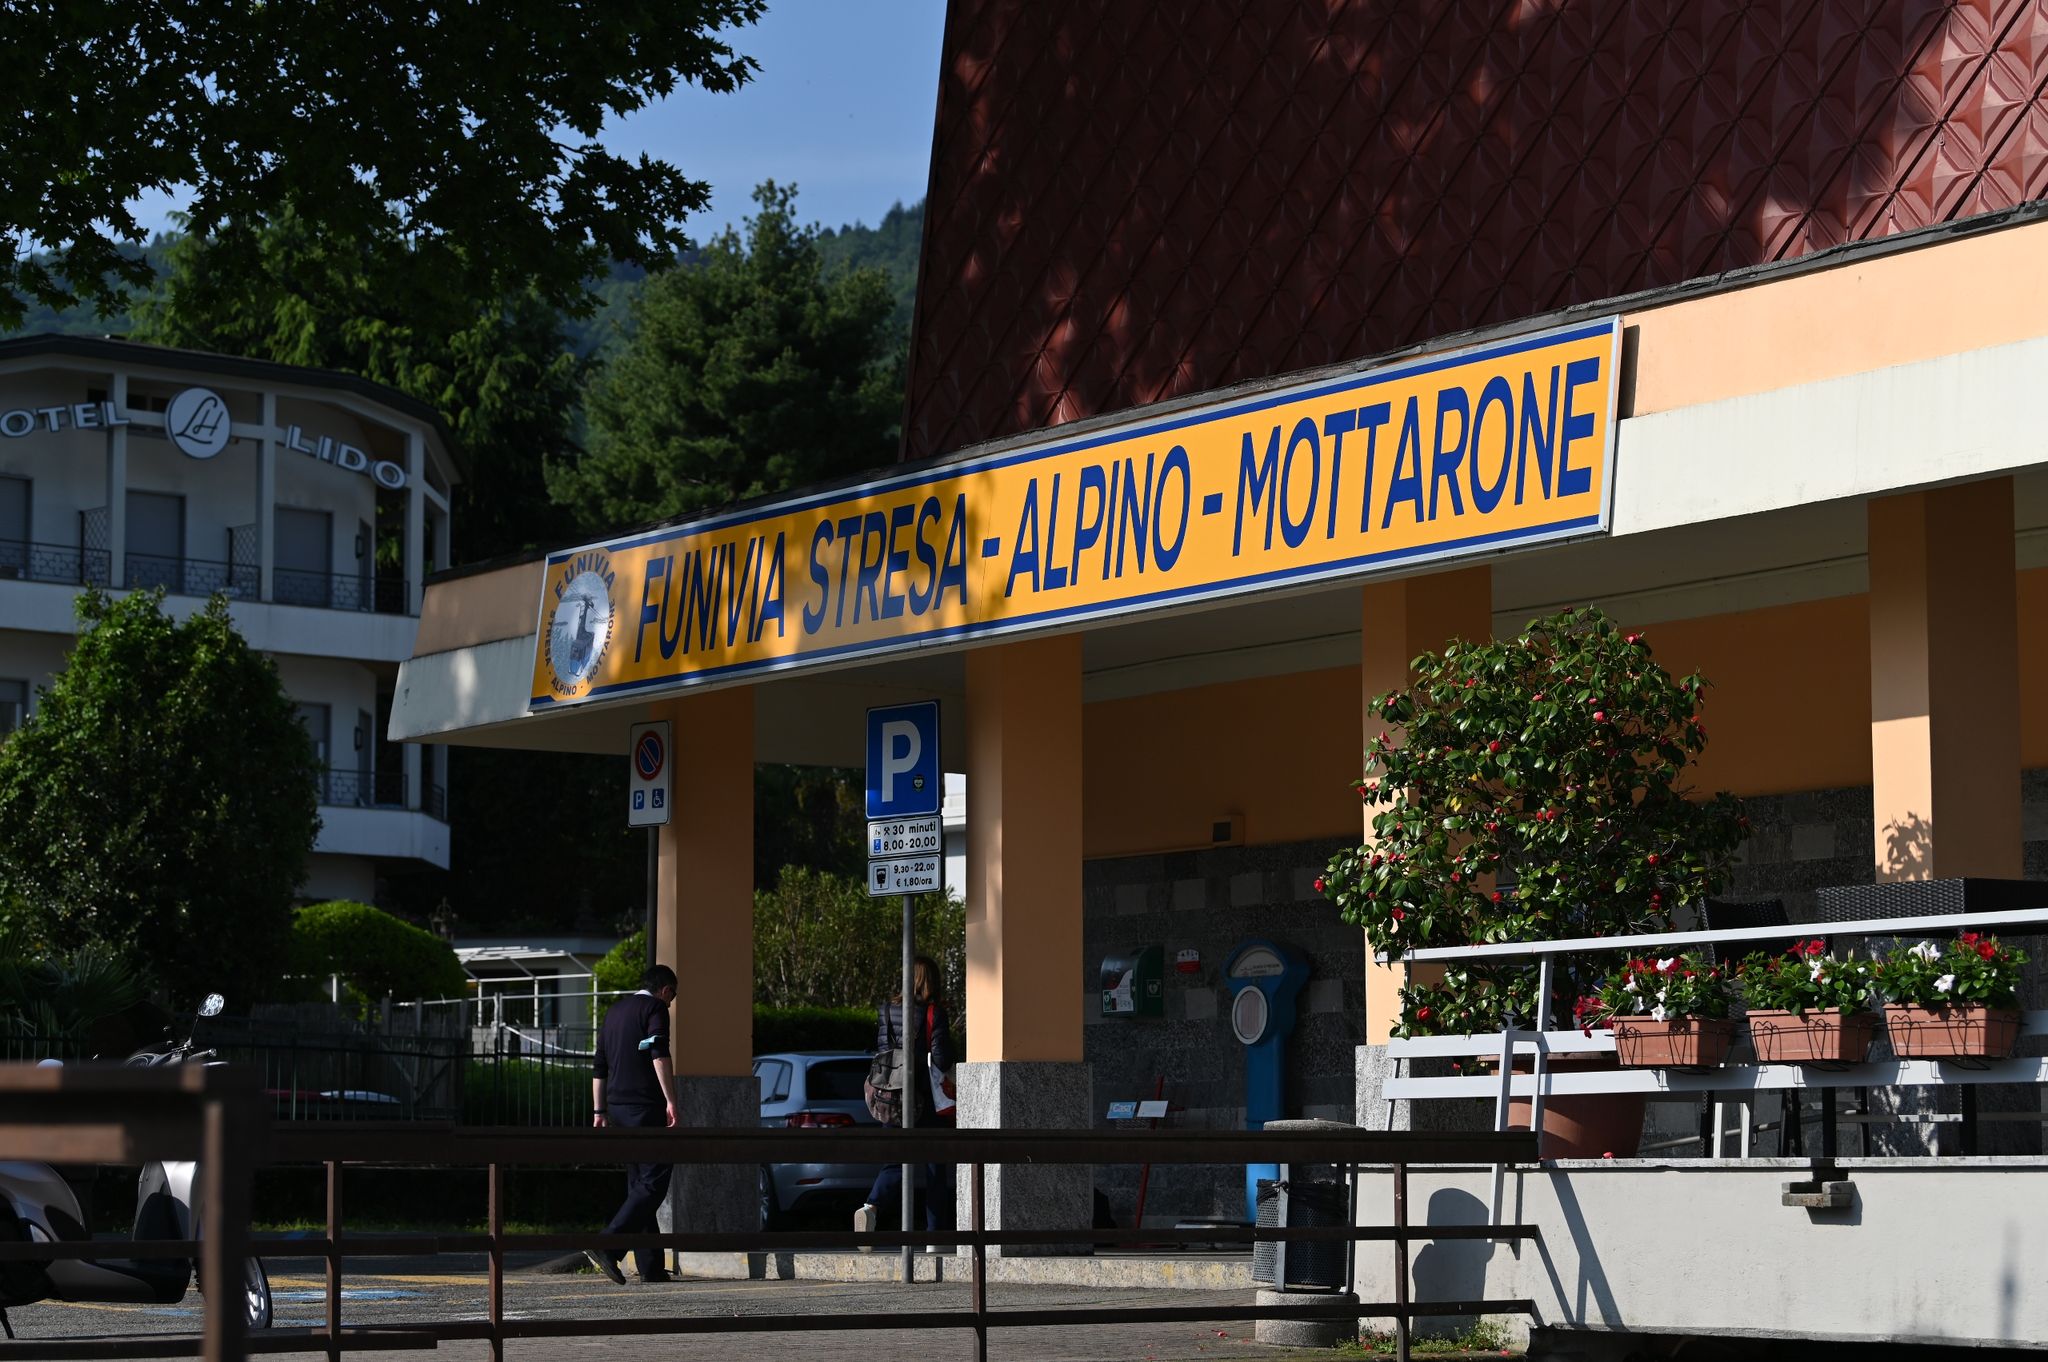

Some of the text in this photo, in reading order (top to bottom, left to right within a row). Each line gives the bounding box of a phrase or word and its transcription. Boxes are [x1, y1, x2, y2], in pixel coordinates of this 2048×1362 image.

[286, 424, 408, 490] LIDO
[634, 531, 786, 663] FUNIVIA
[802, 493, 968, 635] STRESA
[1004, 444, 1191, 598] ALPINO
[1232, 356, 1600, 557] MOTTARONE
[555, 553, 616, 599] FUNIVIA
[550, 678, 578, 696] ALPINO
[586, 599, 616, 685] MOTTARONE
[881, 720, 922, 803] P
[635, 792, 644, 808] P
[892, 821, 937, 836] 30 minuti
